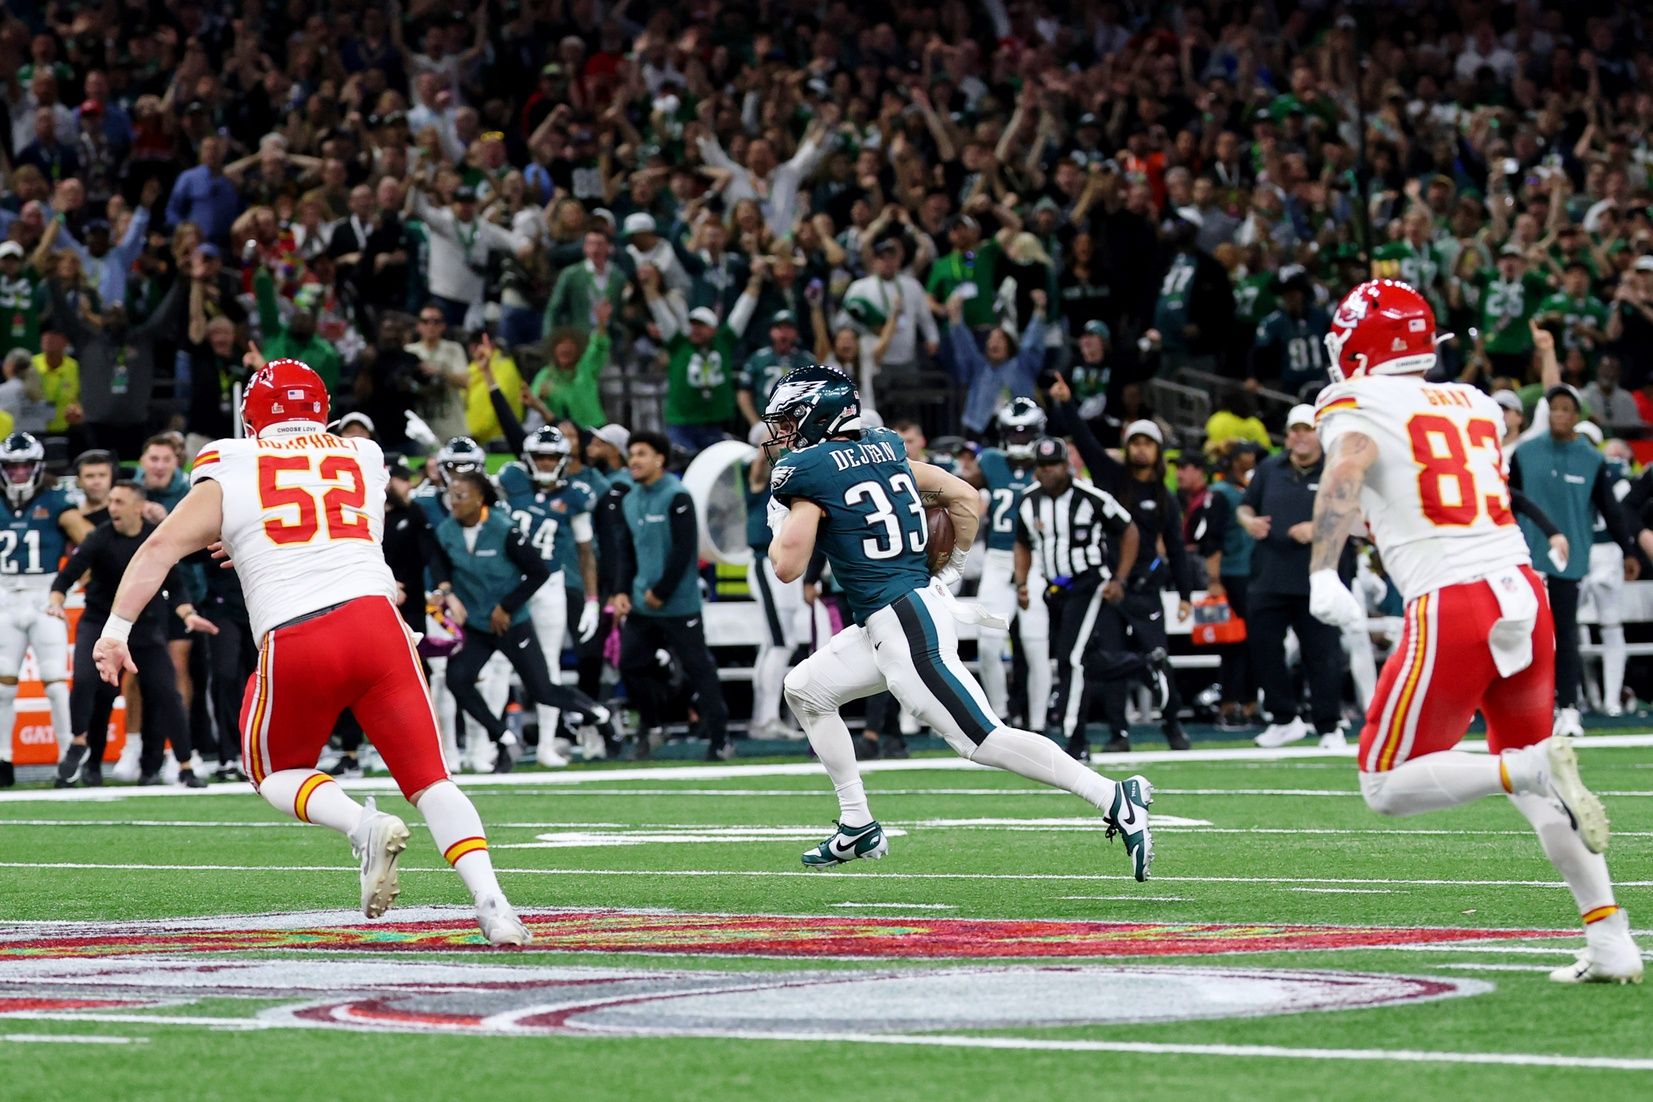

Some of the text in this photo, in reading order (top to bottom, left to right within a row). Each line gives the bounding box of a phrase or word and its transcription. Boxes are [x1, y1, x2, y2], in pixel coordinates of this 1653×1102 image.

[257, 455, 374, 545] 52
[1405, 412, 1517, 528] 83
[0, 529, 44, 574] 21
[844, 473, 929, 560] 33
